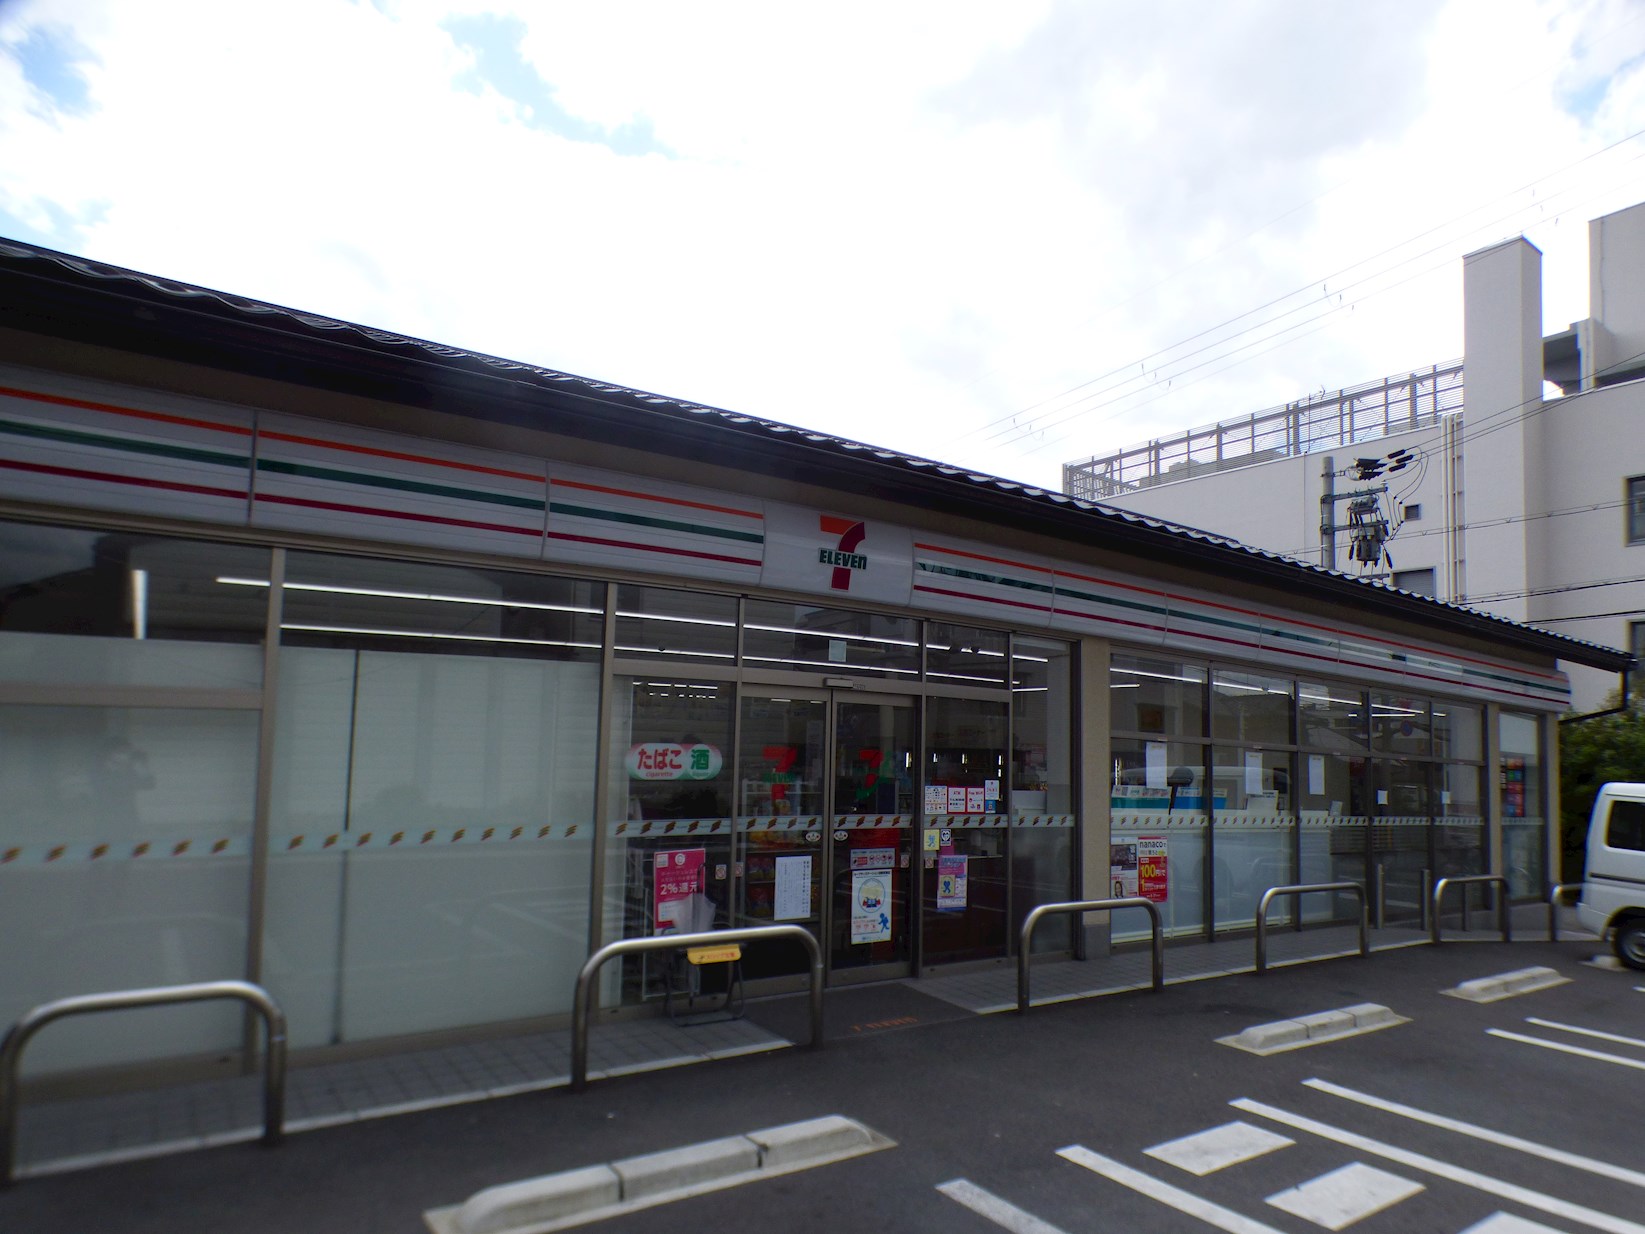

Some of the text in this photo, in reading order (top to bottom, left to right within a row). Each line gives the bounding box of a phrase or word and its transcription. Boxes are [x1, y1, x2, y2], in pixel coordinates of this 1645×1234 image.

[637, 748, 710, 770] たばこ 酒
